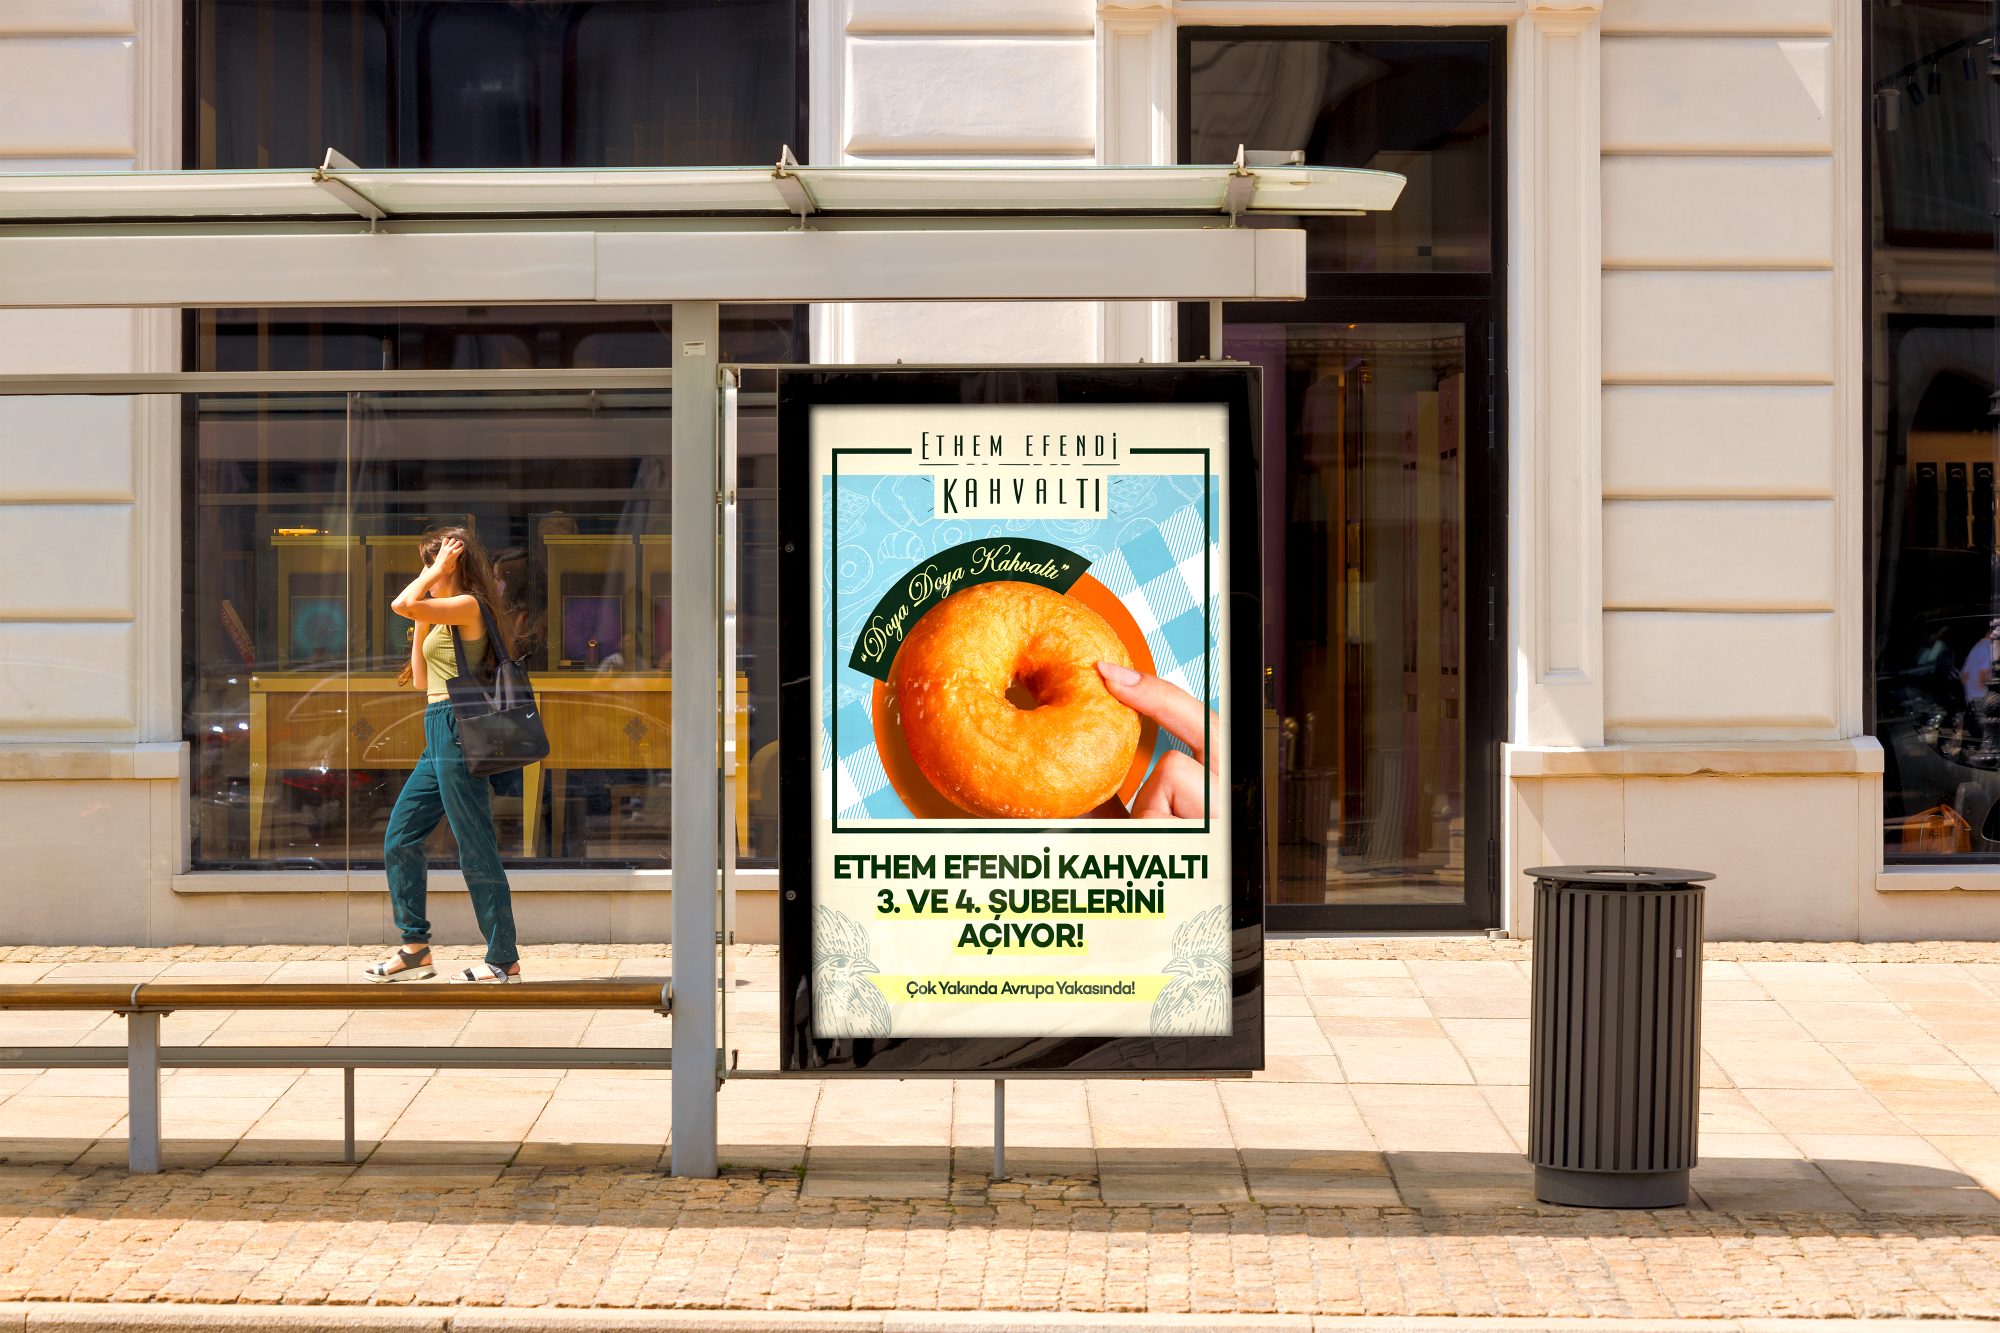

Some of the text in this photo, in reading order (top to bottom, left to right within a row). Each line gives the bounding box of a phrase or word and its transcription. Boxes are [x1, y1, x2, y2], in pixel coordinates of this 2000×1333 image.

[922, 432, 1002, 460] ETHEM
[943, 478, 1100, 514] KAHVALTI
[908, 564, 965, 607] Doya
[834, 846, 1208, 879] ETHEM EFENDİ KAHVALTI
[876, 880, 1165, 921] 3. VE 4. ŞUBELERİNİ
[957, 922, 1084, 955] AÇIYOR!
[906, 980, 1136, 999] Çok Yakında Avrupa Yakasında!
